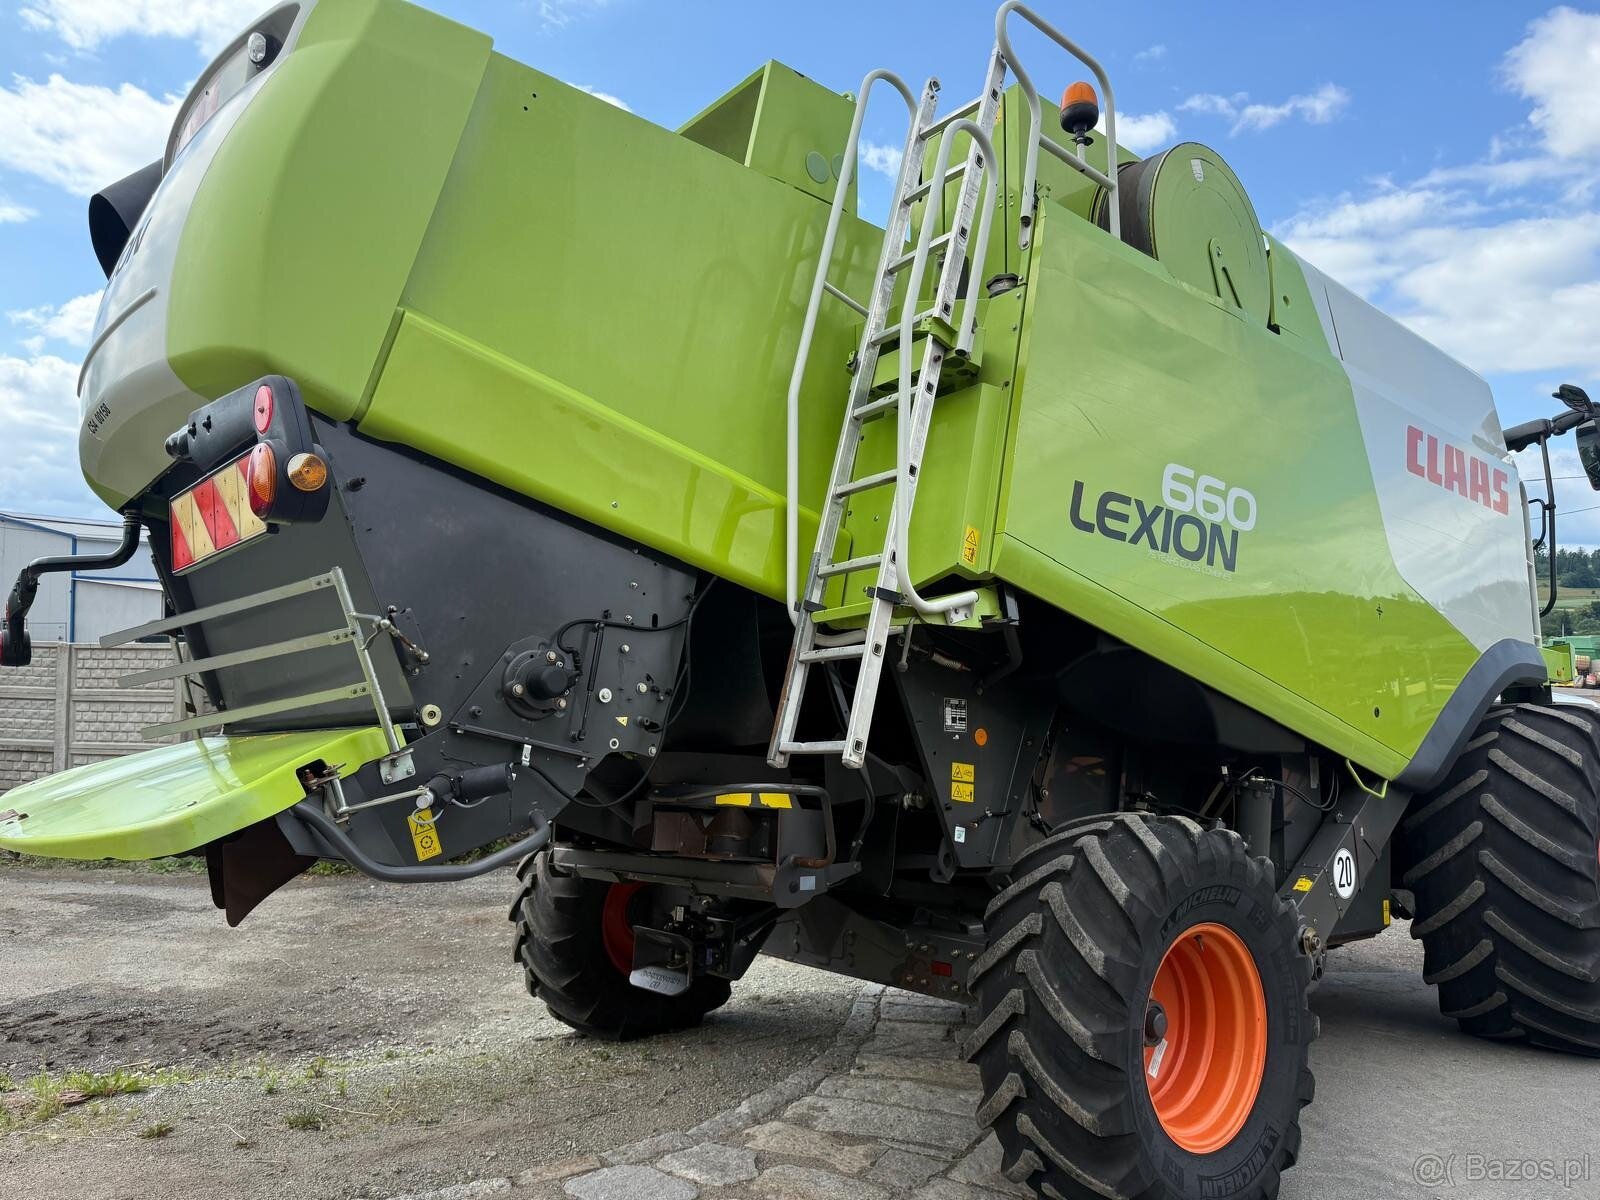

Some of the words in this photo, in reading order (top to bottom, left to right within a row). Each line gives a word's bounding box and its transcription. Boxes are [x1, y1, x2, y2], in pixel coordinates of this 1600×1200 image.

[1161, 463, 1257, 531] 660
[1406, 424, 1509, 516] CLAAS
[1069, 479, 1239, 573] LEXION
[421, 847, 437, 858] STOP
[1337, 855, 1353, 888] 20
[1174, 885, 1241, 921] MICHELIN
[1200, 1144, 1267, 1198] MICHELIN
